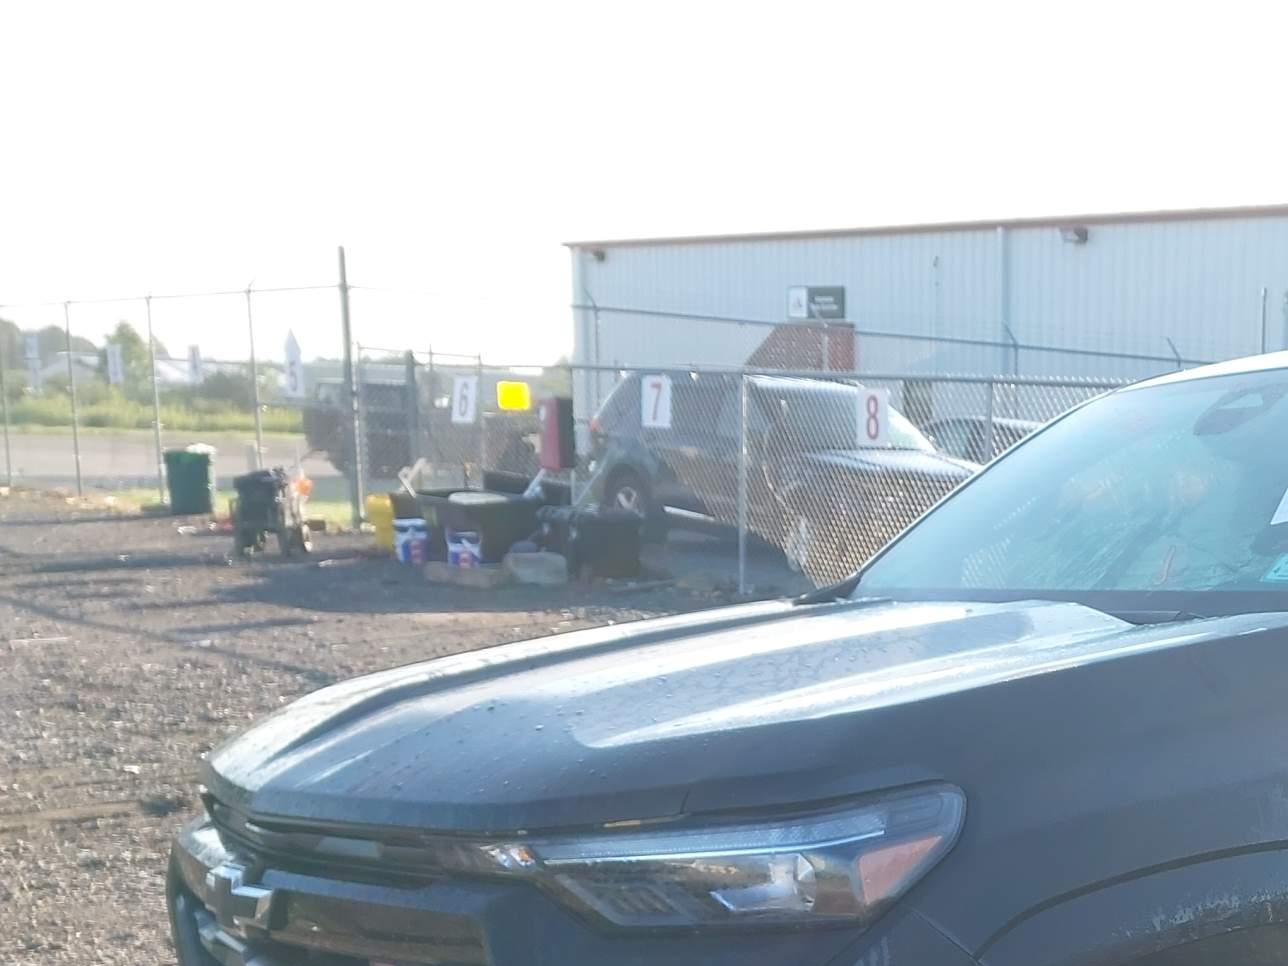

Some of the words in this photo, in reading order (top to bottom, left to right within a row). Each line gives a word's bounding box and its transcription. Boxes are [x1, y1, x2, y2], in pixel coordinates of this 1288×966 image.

[459, 380, 469, 418] 6
[650, 382, 662, 422] 7
[866, 395, 879, 440] 8
